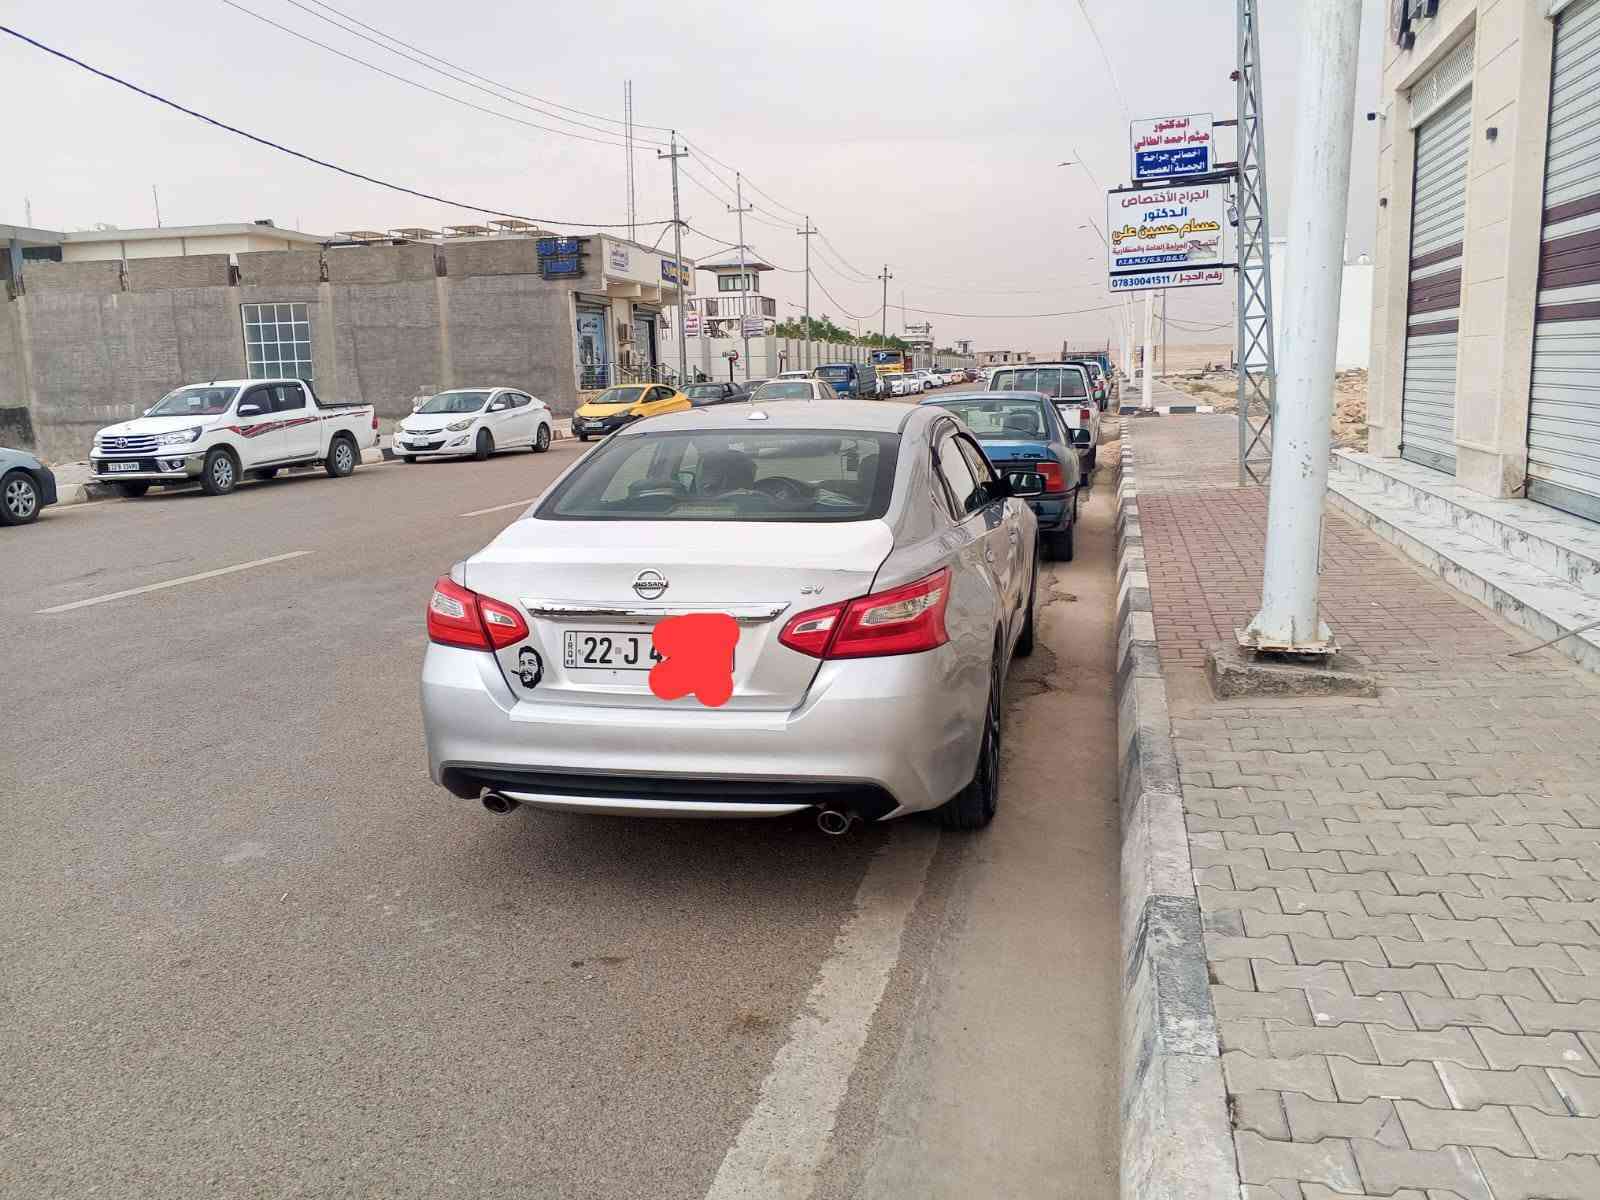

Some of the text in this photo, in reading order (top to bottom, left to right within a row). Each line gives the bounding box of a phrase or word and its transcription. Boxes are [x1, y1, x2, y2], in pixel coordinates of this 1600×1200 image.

[1153, 117, 1190, 132] الدكتور
[1179, 190, 1209, 204] الجراح
[1143, 207, 1188, 222] الدكتور
[1112, 218, 1220, 245] حسام حسين علي
[1112, 276, 1170, 288] 07830041511
[800, 584, 824, 594] SV
[583, 637, 613, 663] 22
[624, 637, 639, 664] J
